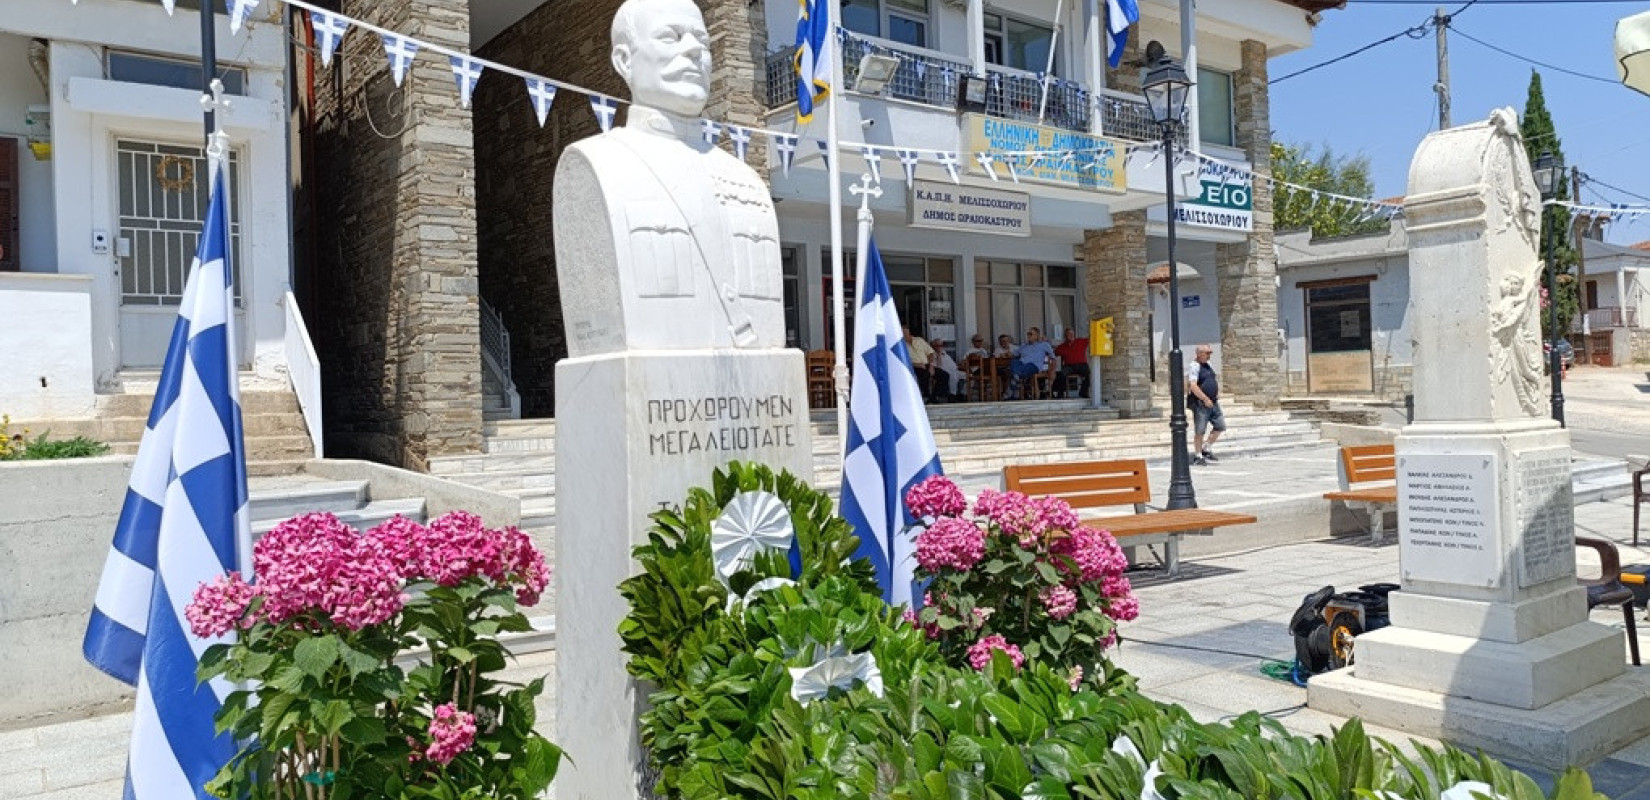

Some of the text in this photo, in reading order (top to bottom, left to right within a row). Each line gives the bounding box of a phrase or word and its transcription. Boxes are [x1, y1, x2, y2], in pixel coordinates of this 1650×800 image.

[984, 118, 1039, 146] ΕΛΛΗΝΙΚΗ
[990, 138, 1025, 152] ΝΟΜΟΣ
[958, 195, 1028, 212] ΜΕΛΙΣΣΟΧΩΡΙΟΥ
[923, 210, 1022, 228] ΔΗΜΟΣ ΩΡΑΙΟΚΑΣΤΡΟΥ
[649, 423, 796, 456] ΜΕΓΑΛΕΙΟΤΑΤΕ
